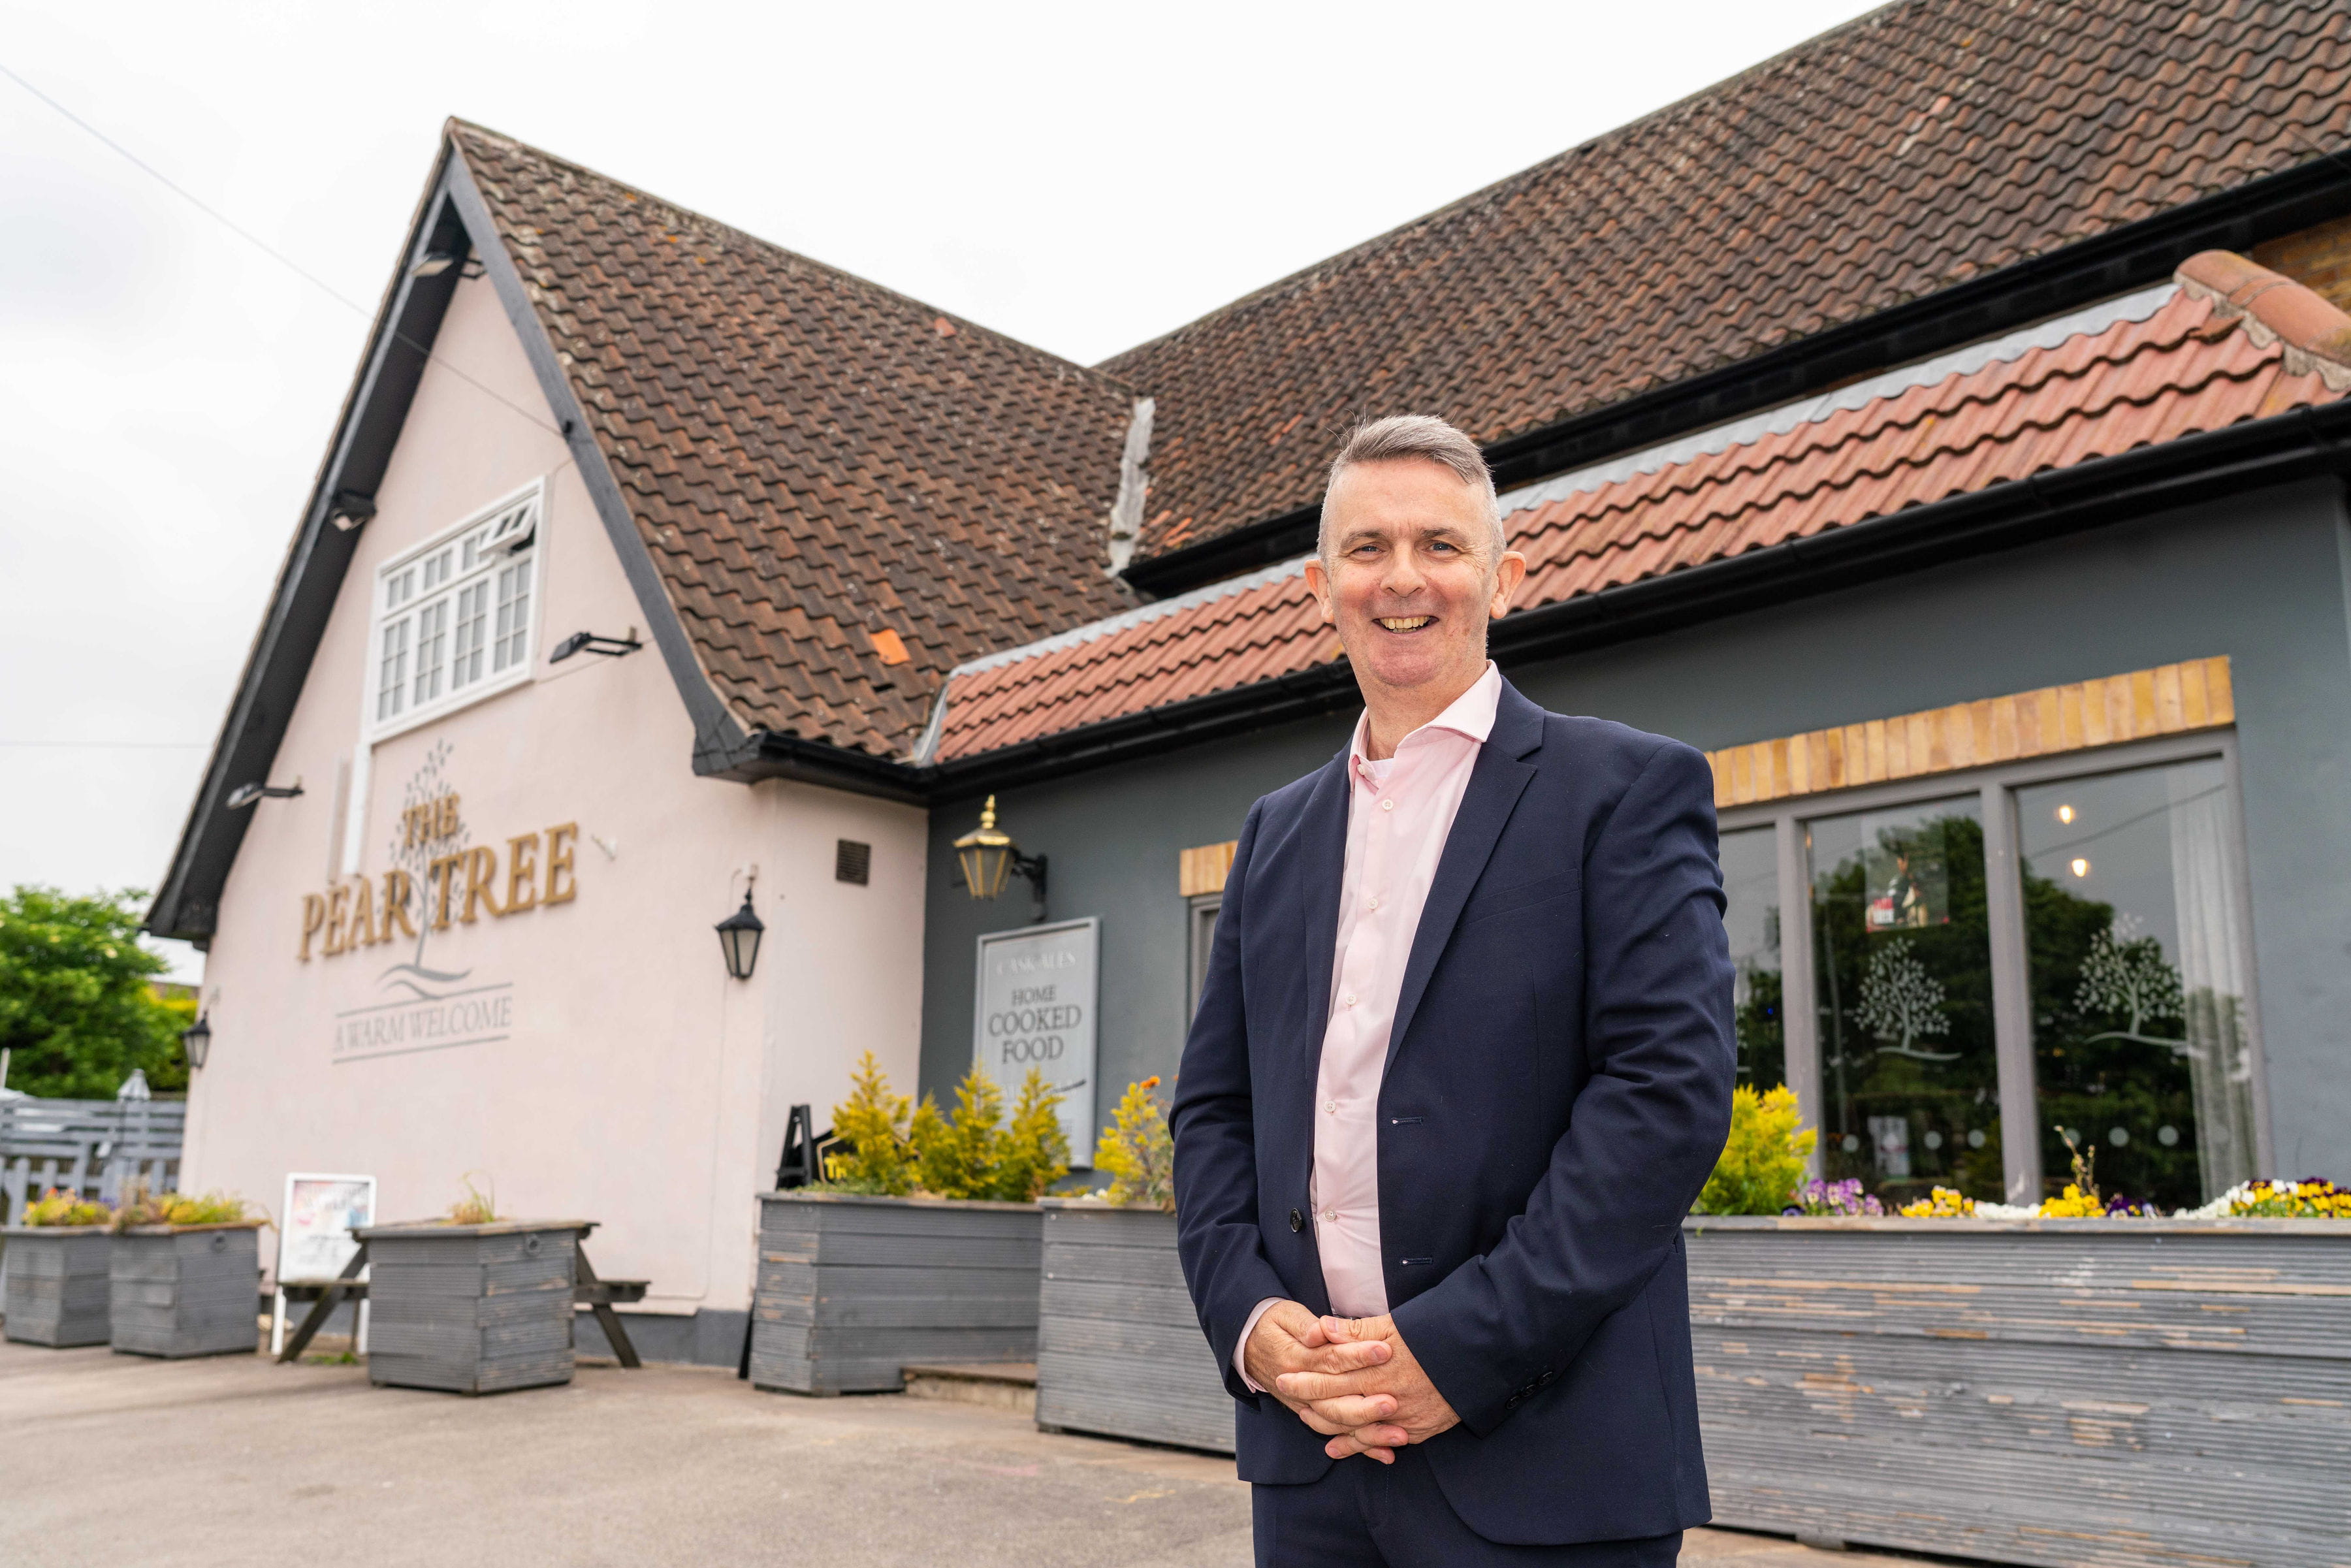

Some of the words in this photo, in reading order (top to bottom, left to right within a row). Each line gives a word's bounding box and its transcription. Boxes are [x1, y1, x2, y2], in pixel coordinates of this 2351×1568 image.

[402, 792, 461, 850] THE
[297, 869, 417, 962] PEAR
[428, 821, 579, 931] TREE
[1012, 985, 1056, 1006] HOME
[334, 1023, 344, 1053] A
[346, 1012, 405, 1048] WARM
[408, 997, 512, 1039] WELCOME
[989, 1004, 1082, 1036] COOKED
[1002, 1036, 1064, 1064] FOOD
